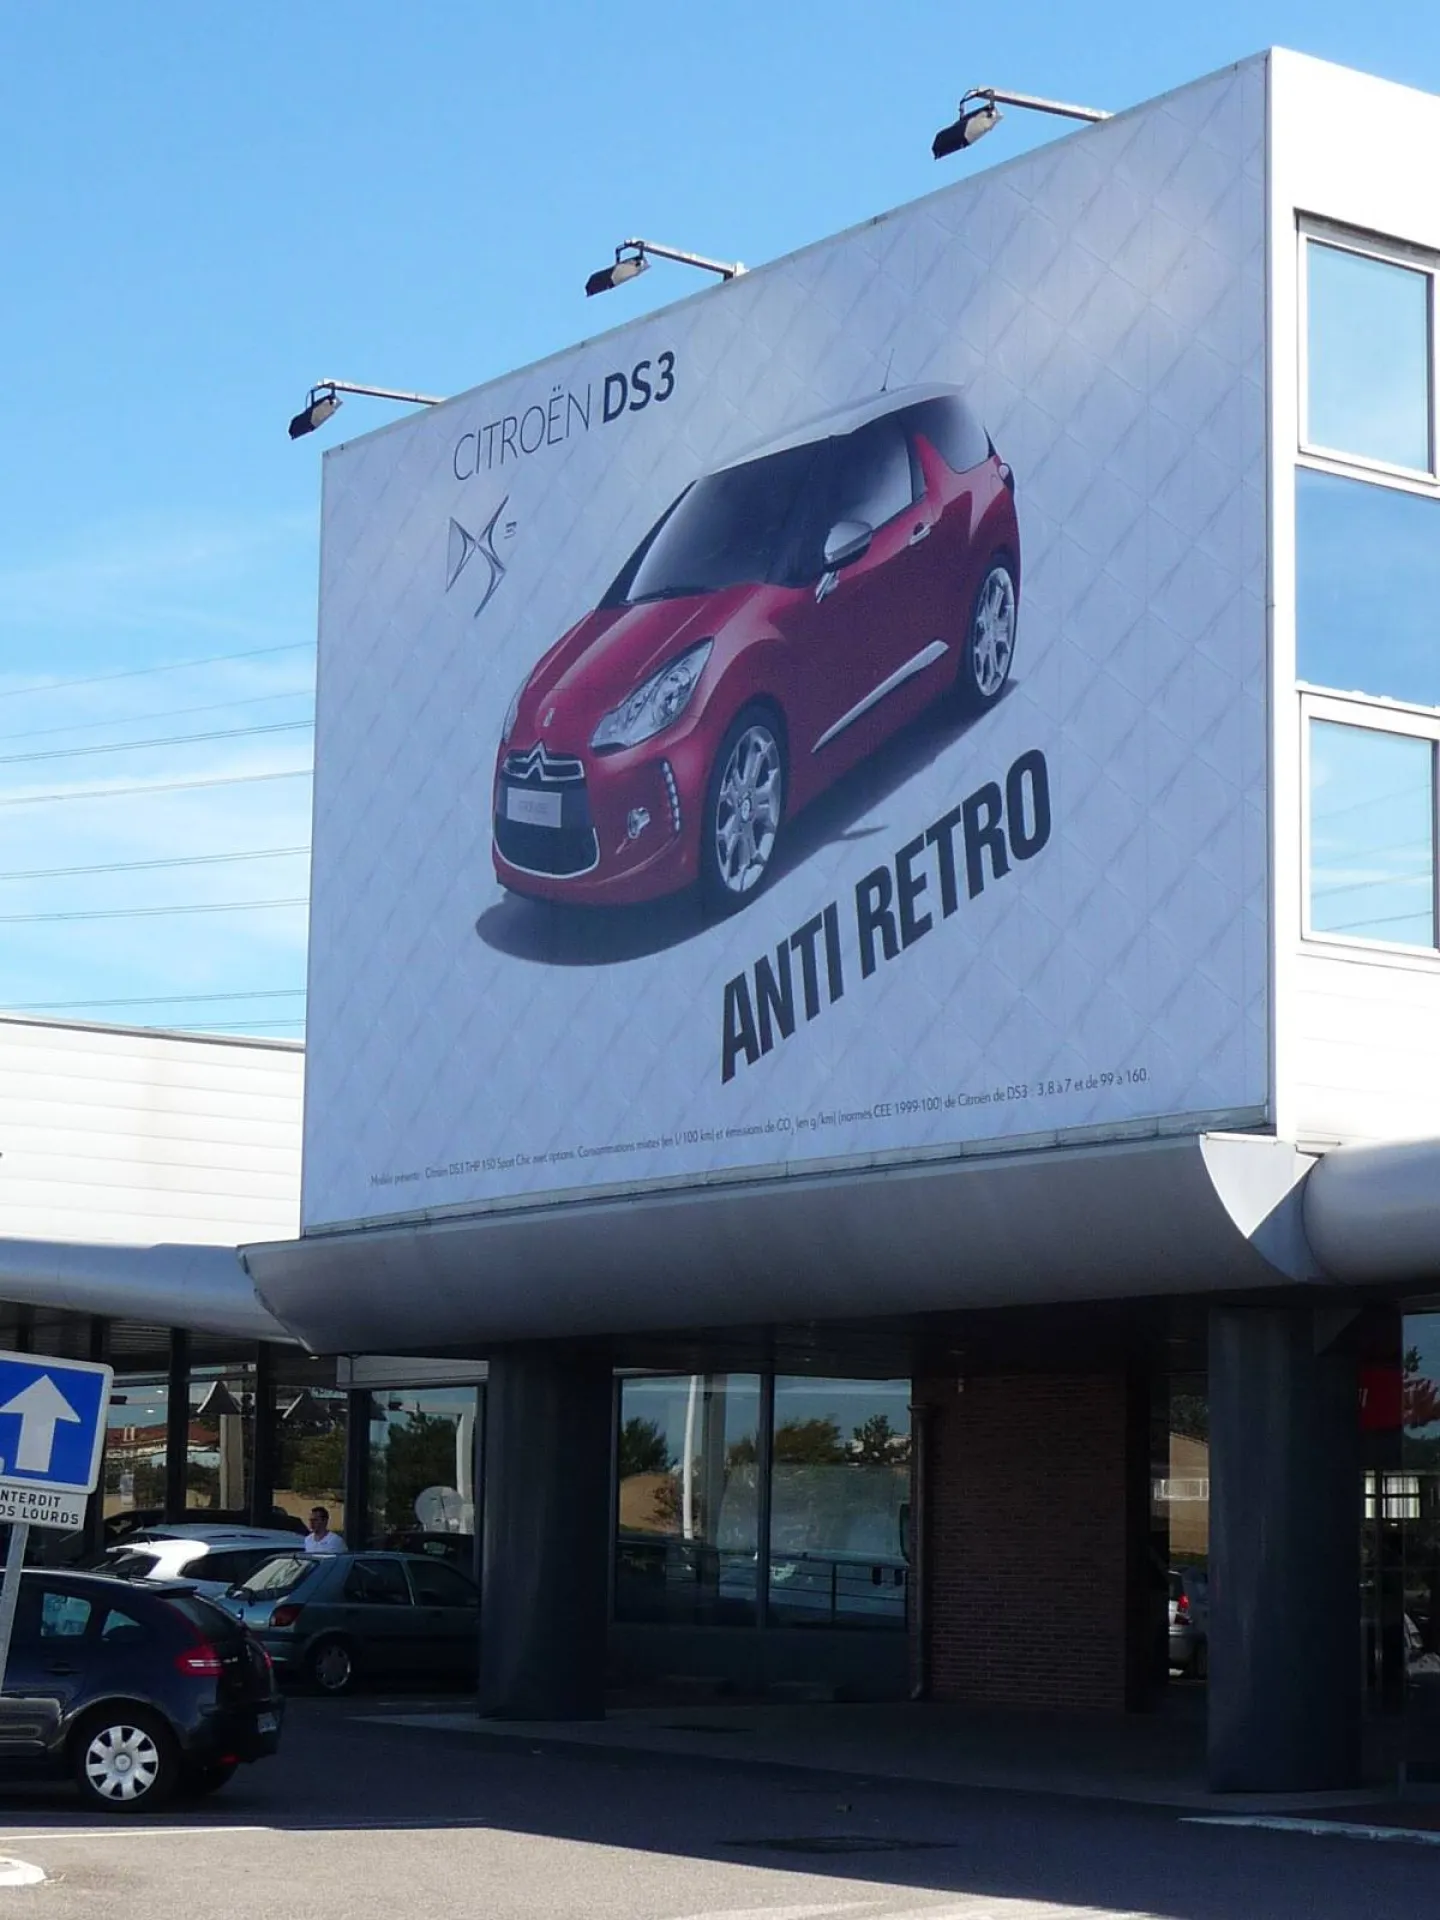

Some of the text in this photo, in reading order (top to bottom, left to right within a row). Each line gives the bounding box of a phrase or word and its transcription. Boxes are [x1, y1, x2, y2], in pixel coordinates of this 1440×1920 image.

[453, 350, 675, 481] CITROËN DS3
[721, 749, 1051, 1085] ANTI RETRO
[873, 1103, 893, 1118] CEE
[993, 1087, 1005, 1102] de
[1006, 1084, 1028, 1100] DS3
[1064, 1078, 1072, 1093] 7
[1099, 1072, 1114, 1086] 99
[0, 1488, 61, 1508] NTERDIT
[22, 1506, 79, 1525] LOURDS
